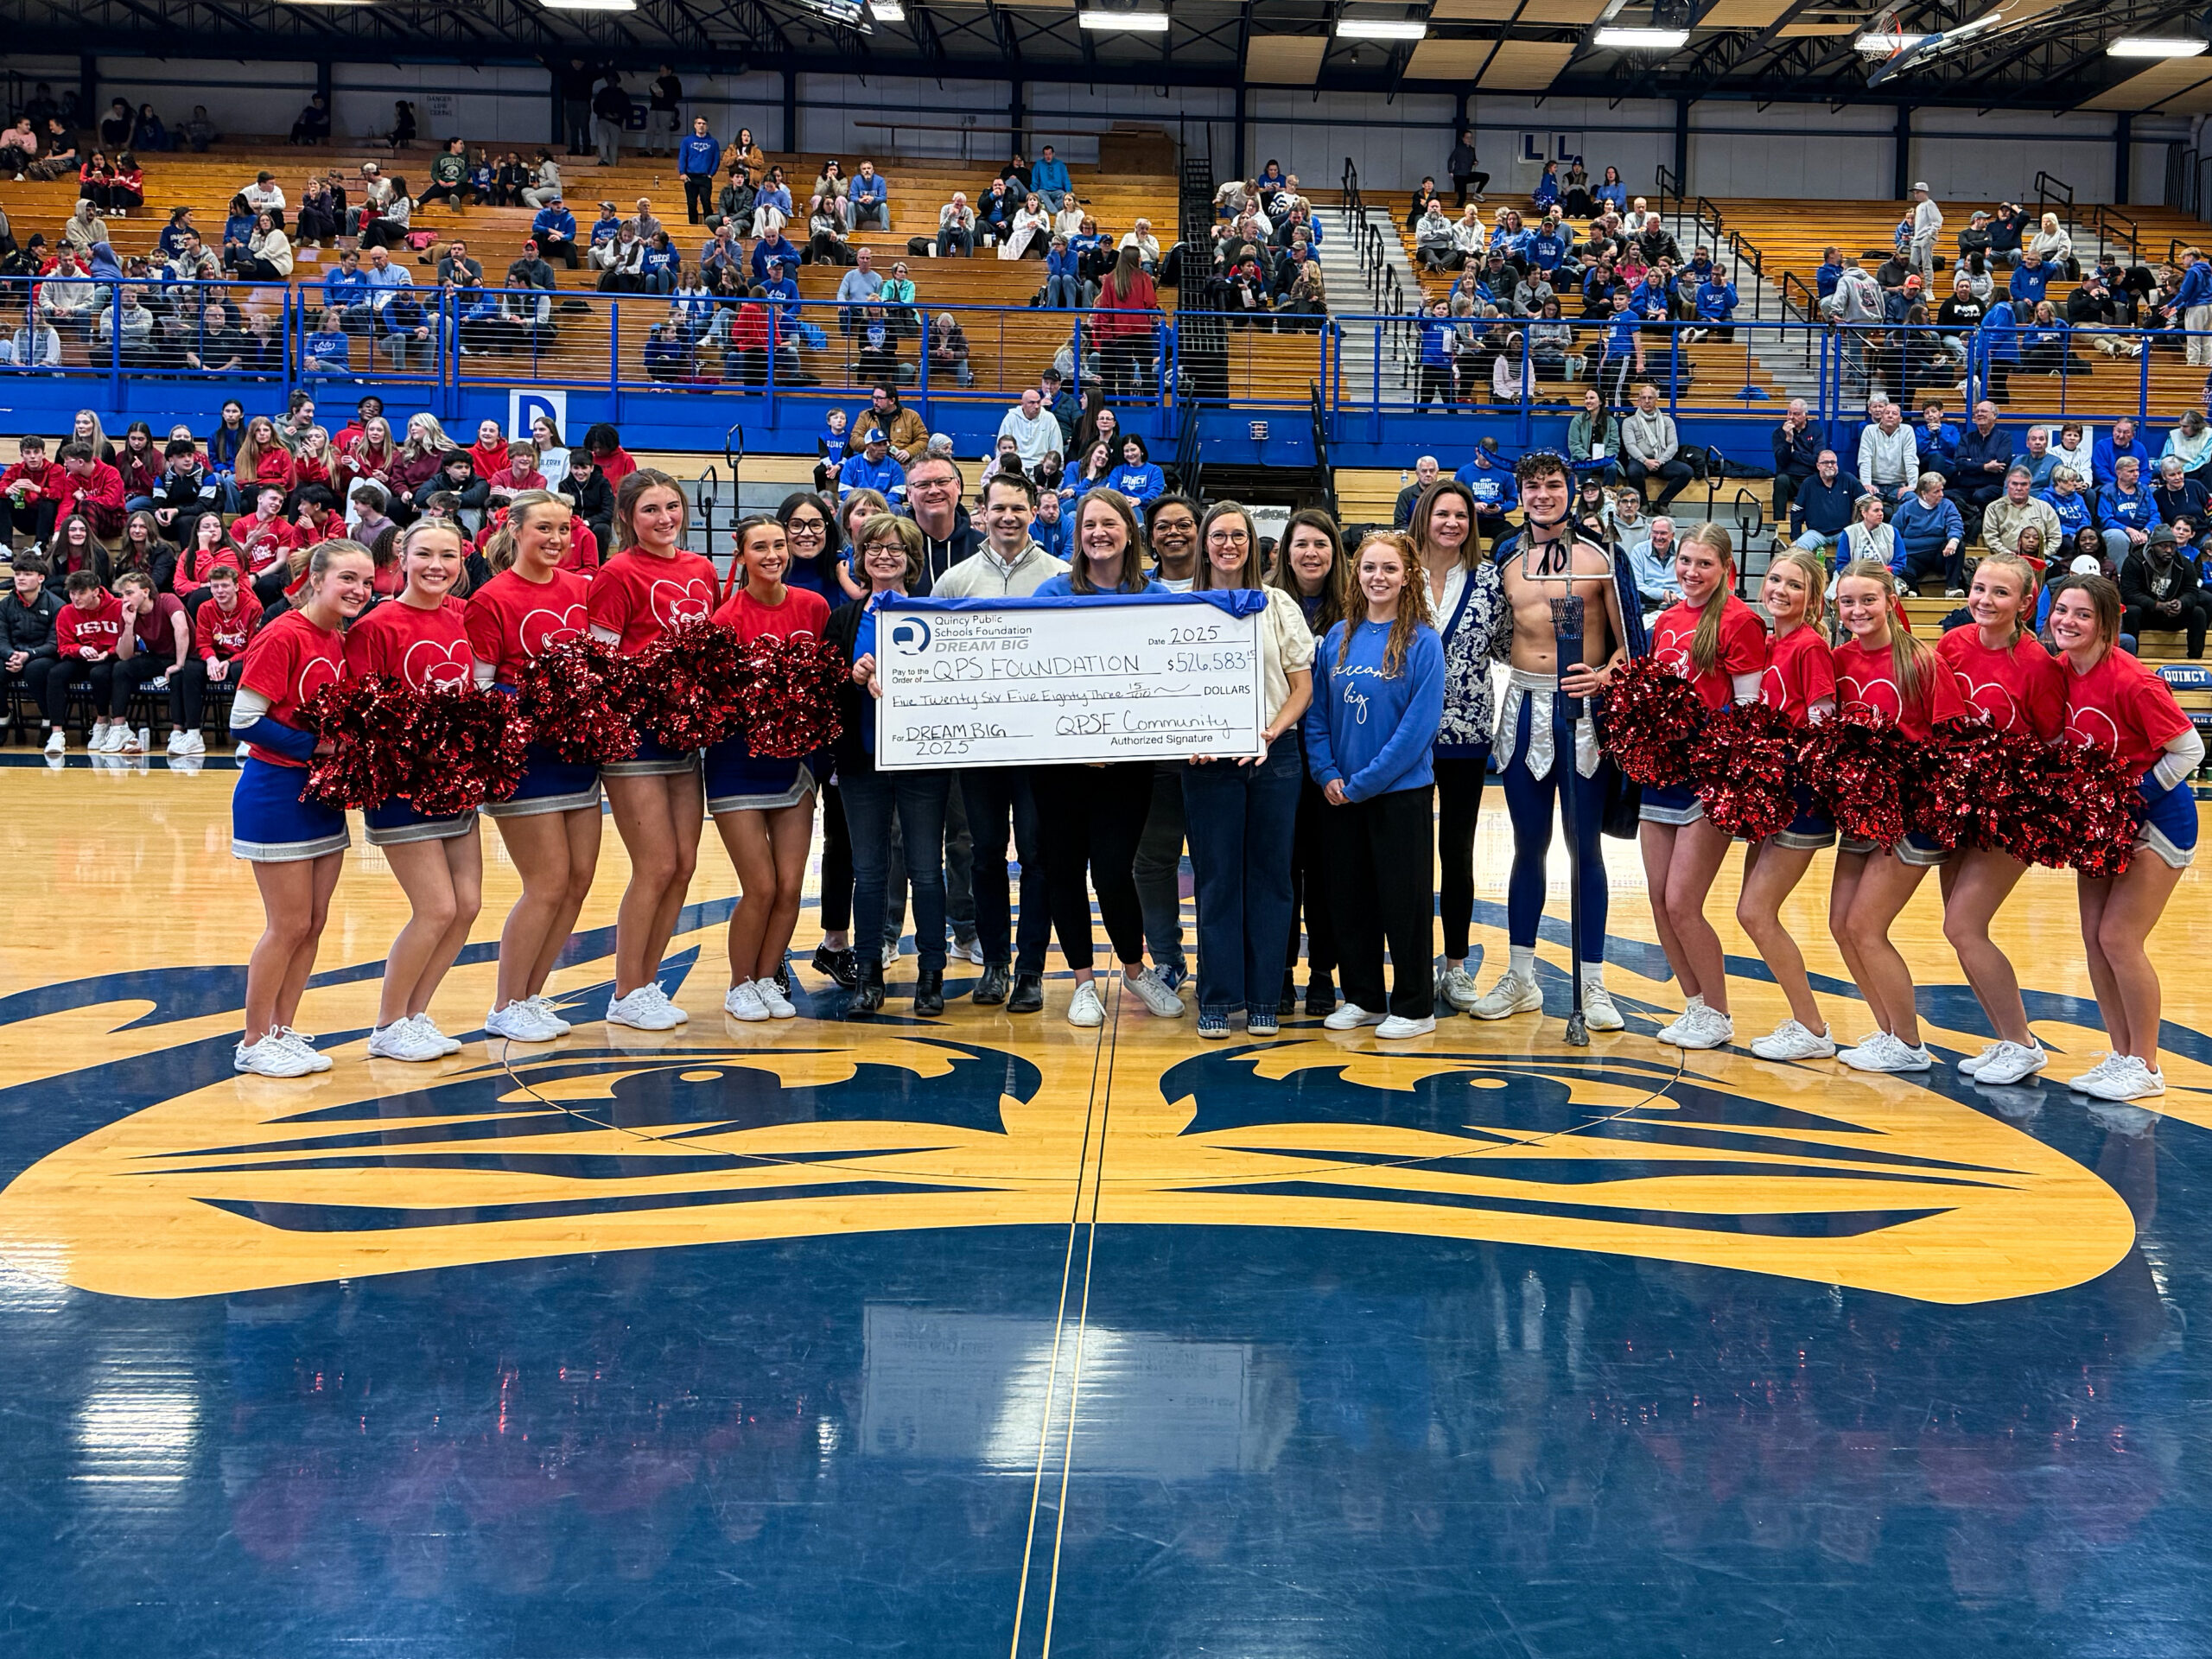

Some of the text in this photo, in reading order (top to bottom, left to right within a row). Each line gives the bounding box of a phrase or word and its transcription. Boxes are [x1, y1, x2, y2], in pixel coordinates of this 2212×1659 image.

[1525, 134, 1574, 161] L L
[518, 395, 556, 438] D
[1472, 482, 1500, 491] QUINCY
[75, 620, 118, 637] ISU
[935, 615, 1002, 626] Quincy Public
[935, 626, 1032, 638] Schools Foundation
[1170, 626, 1221, 645] 2025
[935, 639, 1029, 653] DREAM BIG
[933, 655, 1139, 681] QPS FOUNDATION
[2164, 670, 2206, 683] QUINCY
[1204, 685, 1250, 696] DOLLARS
[893, 695, 917, 707] Five
[919, 693, 978, 710] Twenty
[982, 691, 1001, 703] Six
[1007, 690, 1039, 702] Five
[1087, 690, 1123, 700] Three
[1344, 681, 1370, 725] big
[906, 722, 1007, 741] DREAM BIG
[1056, 709, 1230, 740] QPSF Community
[916, 740, 975, 756] 2025
[1110, 734, 1213, 746] Authorized Signature
